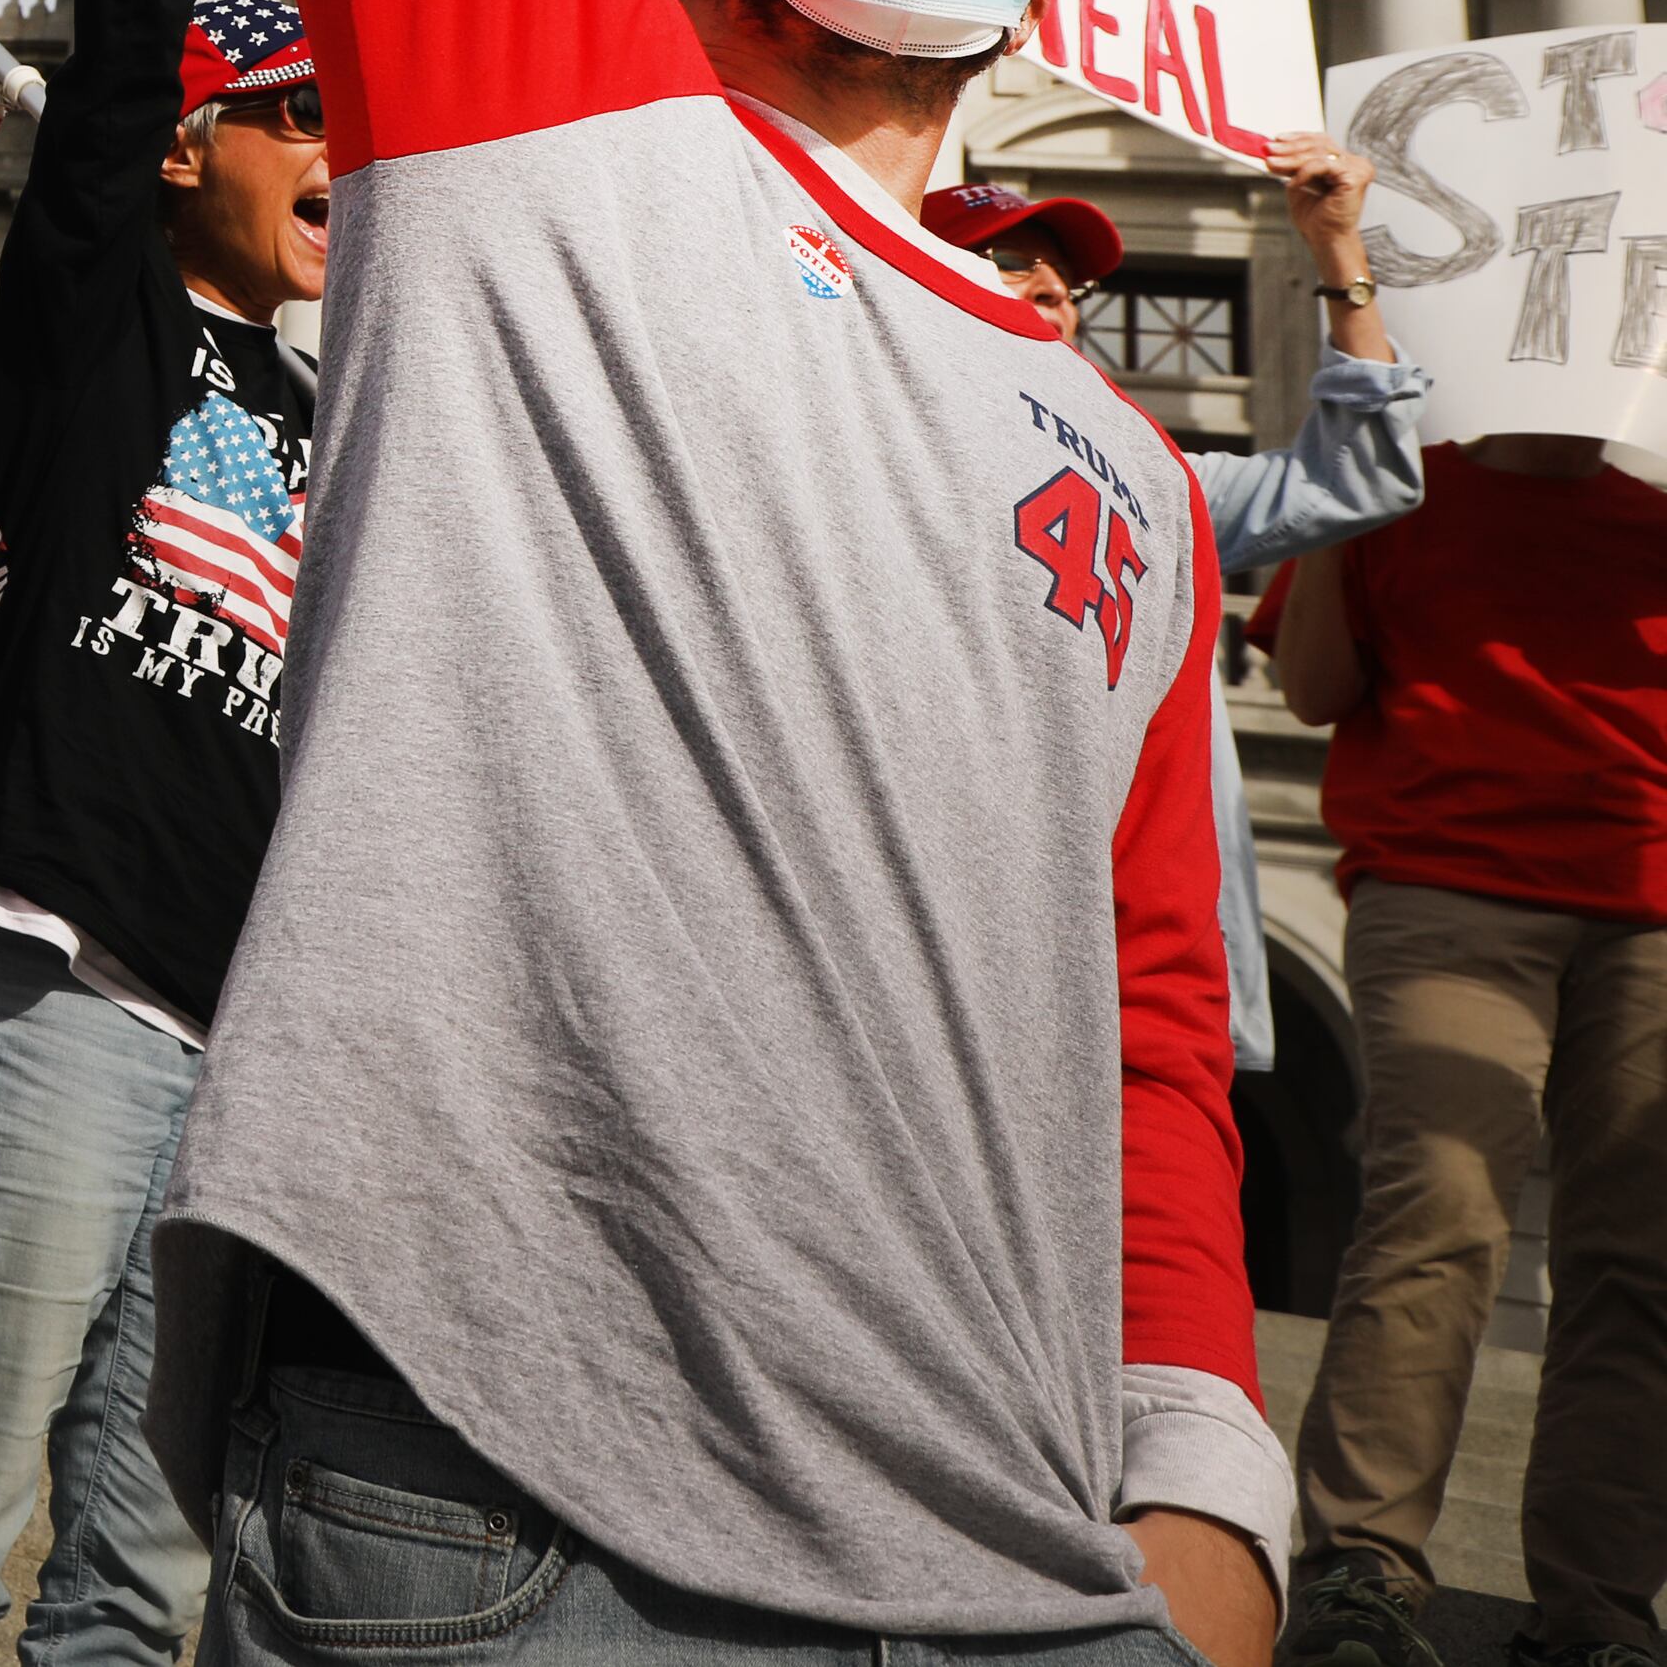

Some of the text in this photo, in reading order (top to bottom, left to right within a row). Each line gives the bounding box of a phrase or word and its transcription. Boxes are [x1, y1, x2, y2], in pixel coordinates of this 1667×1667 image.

[790, 238, 842, 285] VOTED
[1014, 465, 1149, 692] 45
[70, 615, 116, 656] IS
[132, 646, 205, 699] MY
